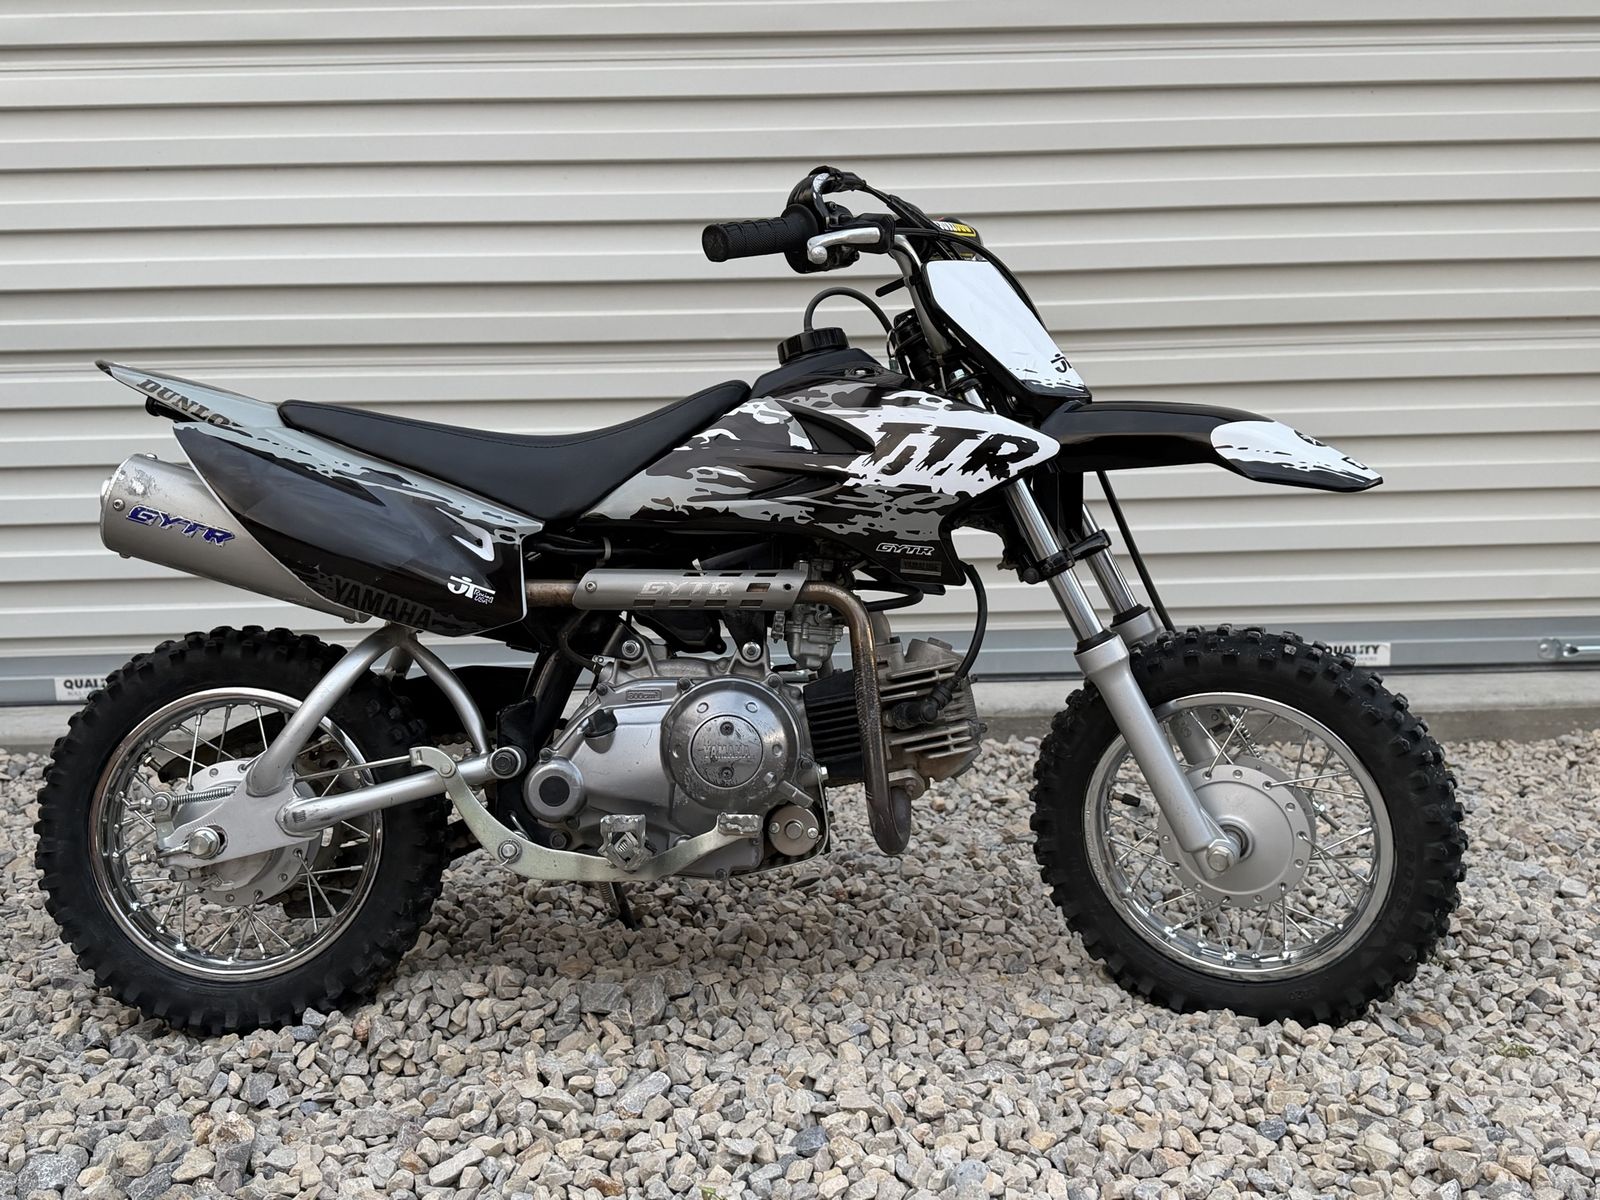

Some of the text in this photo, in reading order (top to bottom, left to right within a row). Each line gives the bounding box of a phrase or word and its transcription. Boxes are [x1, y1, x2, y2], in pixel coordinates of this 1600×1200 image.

[136, 378, 243, 428] DUNLO
[126, 504, 235, 547] GYTR
[875, 542, 935, 556] GYTR
[638, 581, 735, 597] GYTR
[334, 577, 432, 628] YAMAHA
[63, 679, 106, 691] QUAL
[703, 743, 751, 760] YAMAHA
